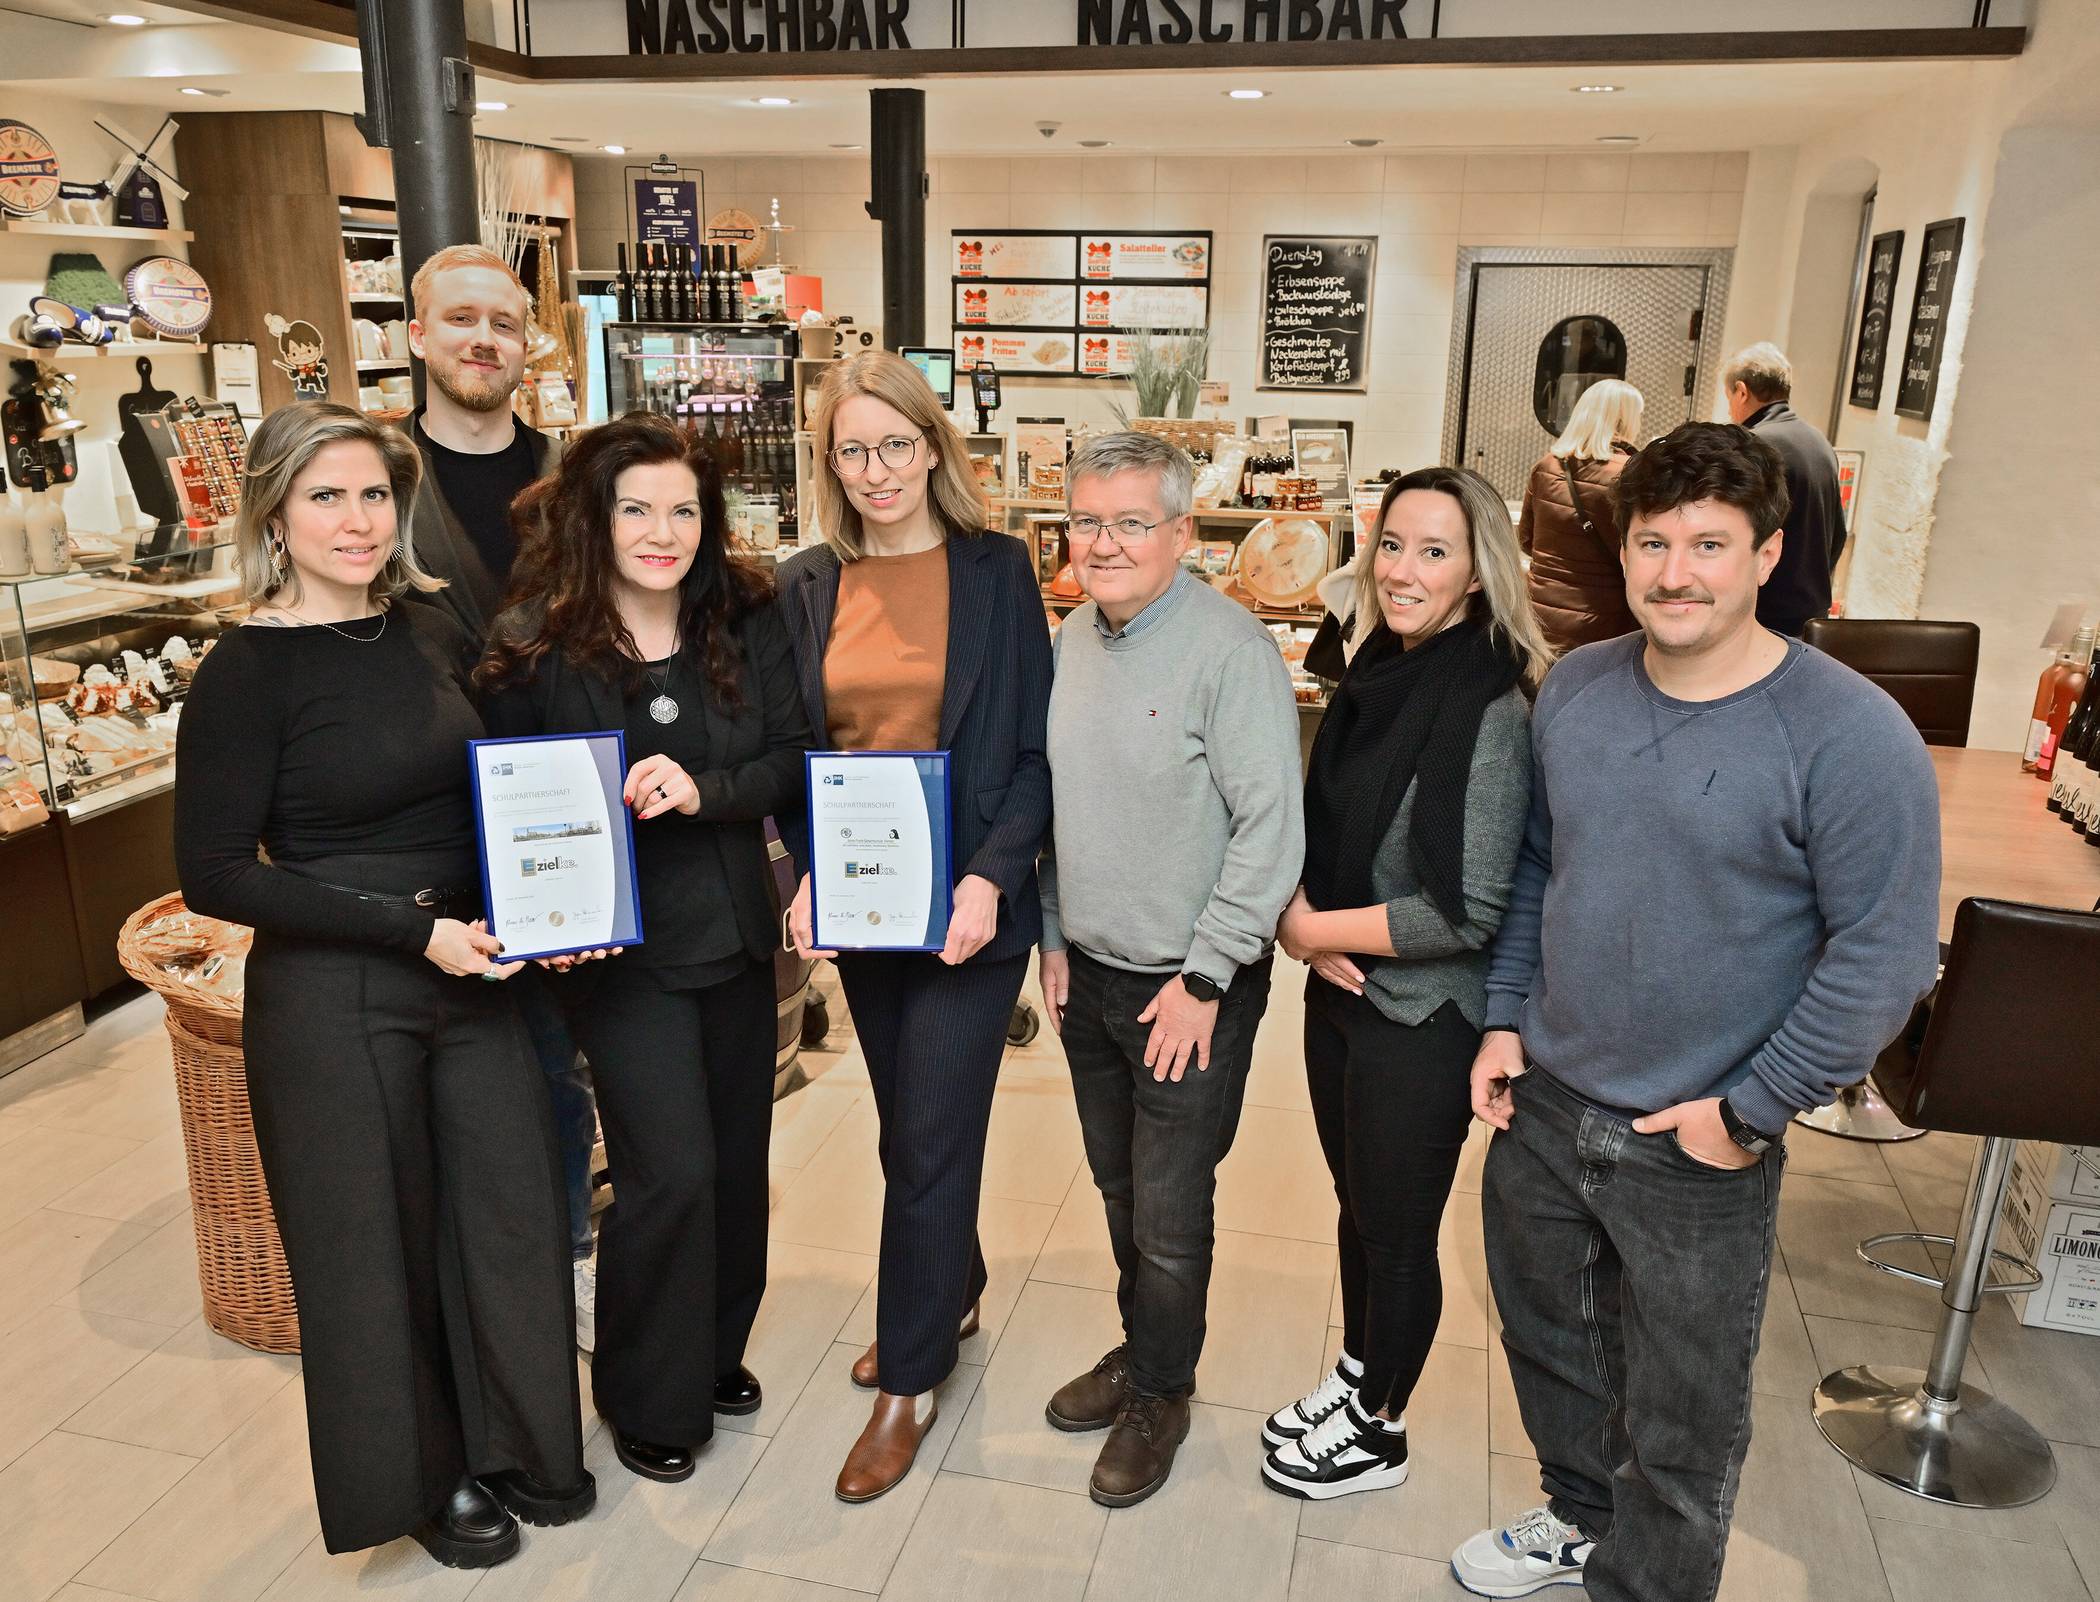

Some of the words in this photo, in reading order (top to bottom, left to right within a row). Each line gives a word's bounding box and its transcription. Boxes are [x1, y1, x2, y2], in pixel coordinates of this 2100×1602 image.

[626, 0, 912, 55] NASCHBAR
[1077, 0, 1408, 46] NASCHBAR
[1119, 244, 1166, 253] Salatteller
[1277, 274, 1346, 289] Erbsensuppe
[1276, 288, 1352, 303] Bockwursteinlage
[1273, 315, 1312, 327] Brötchen
[1270, 334, 1331, 348] Geschmortes
[1270, 347, 1327, 360] Nackensteak
[1329, 344, 1346, 357] mit
[492, 788, 570, 802] SCHULPARTNERSCHAFT
[823, 801, 896, 809] SCHULPARTNERSCHAFT
